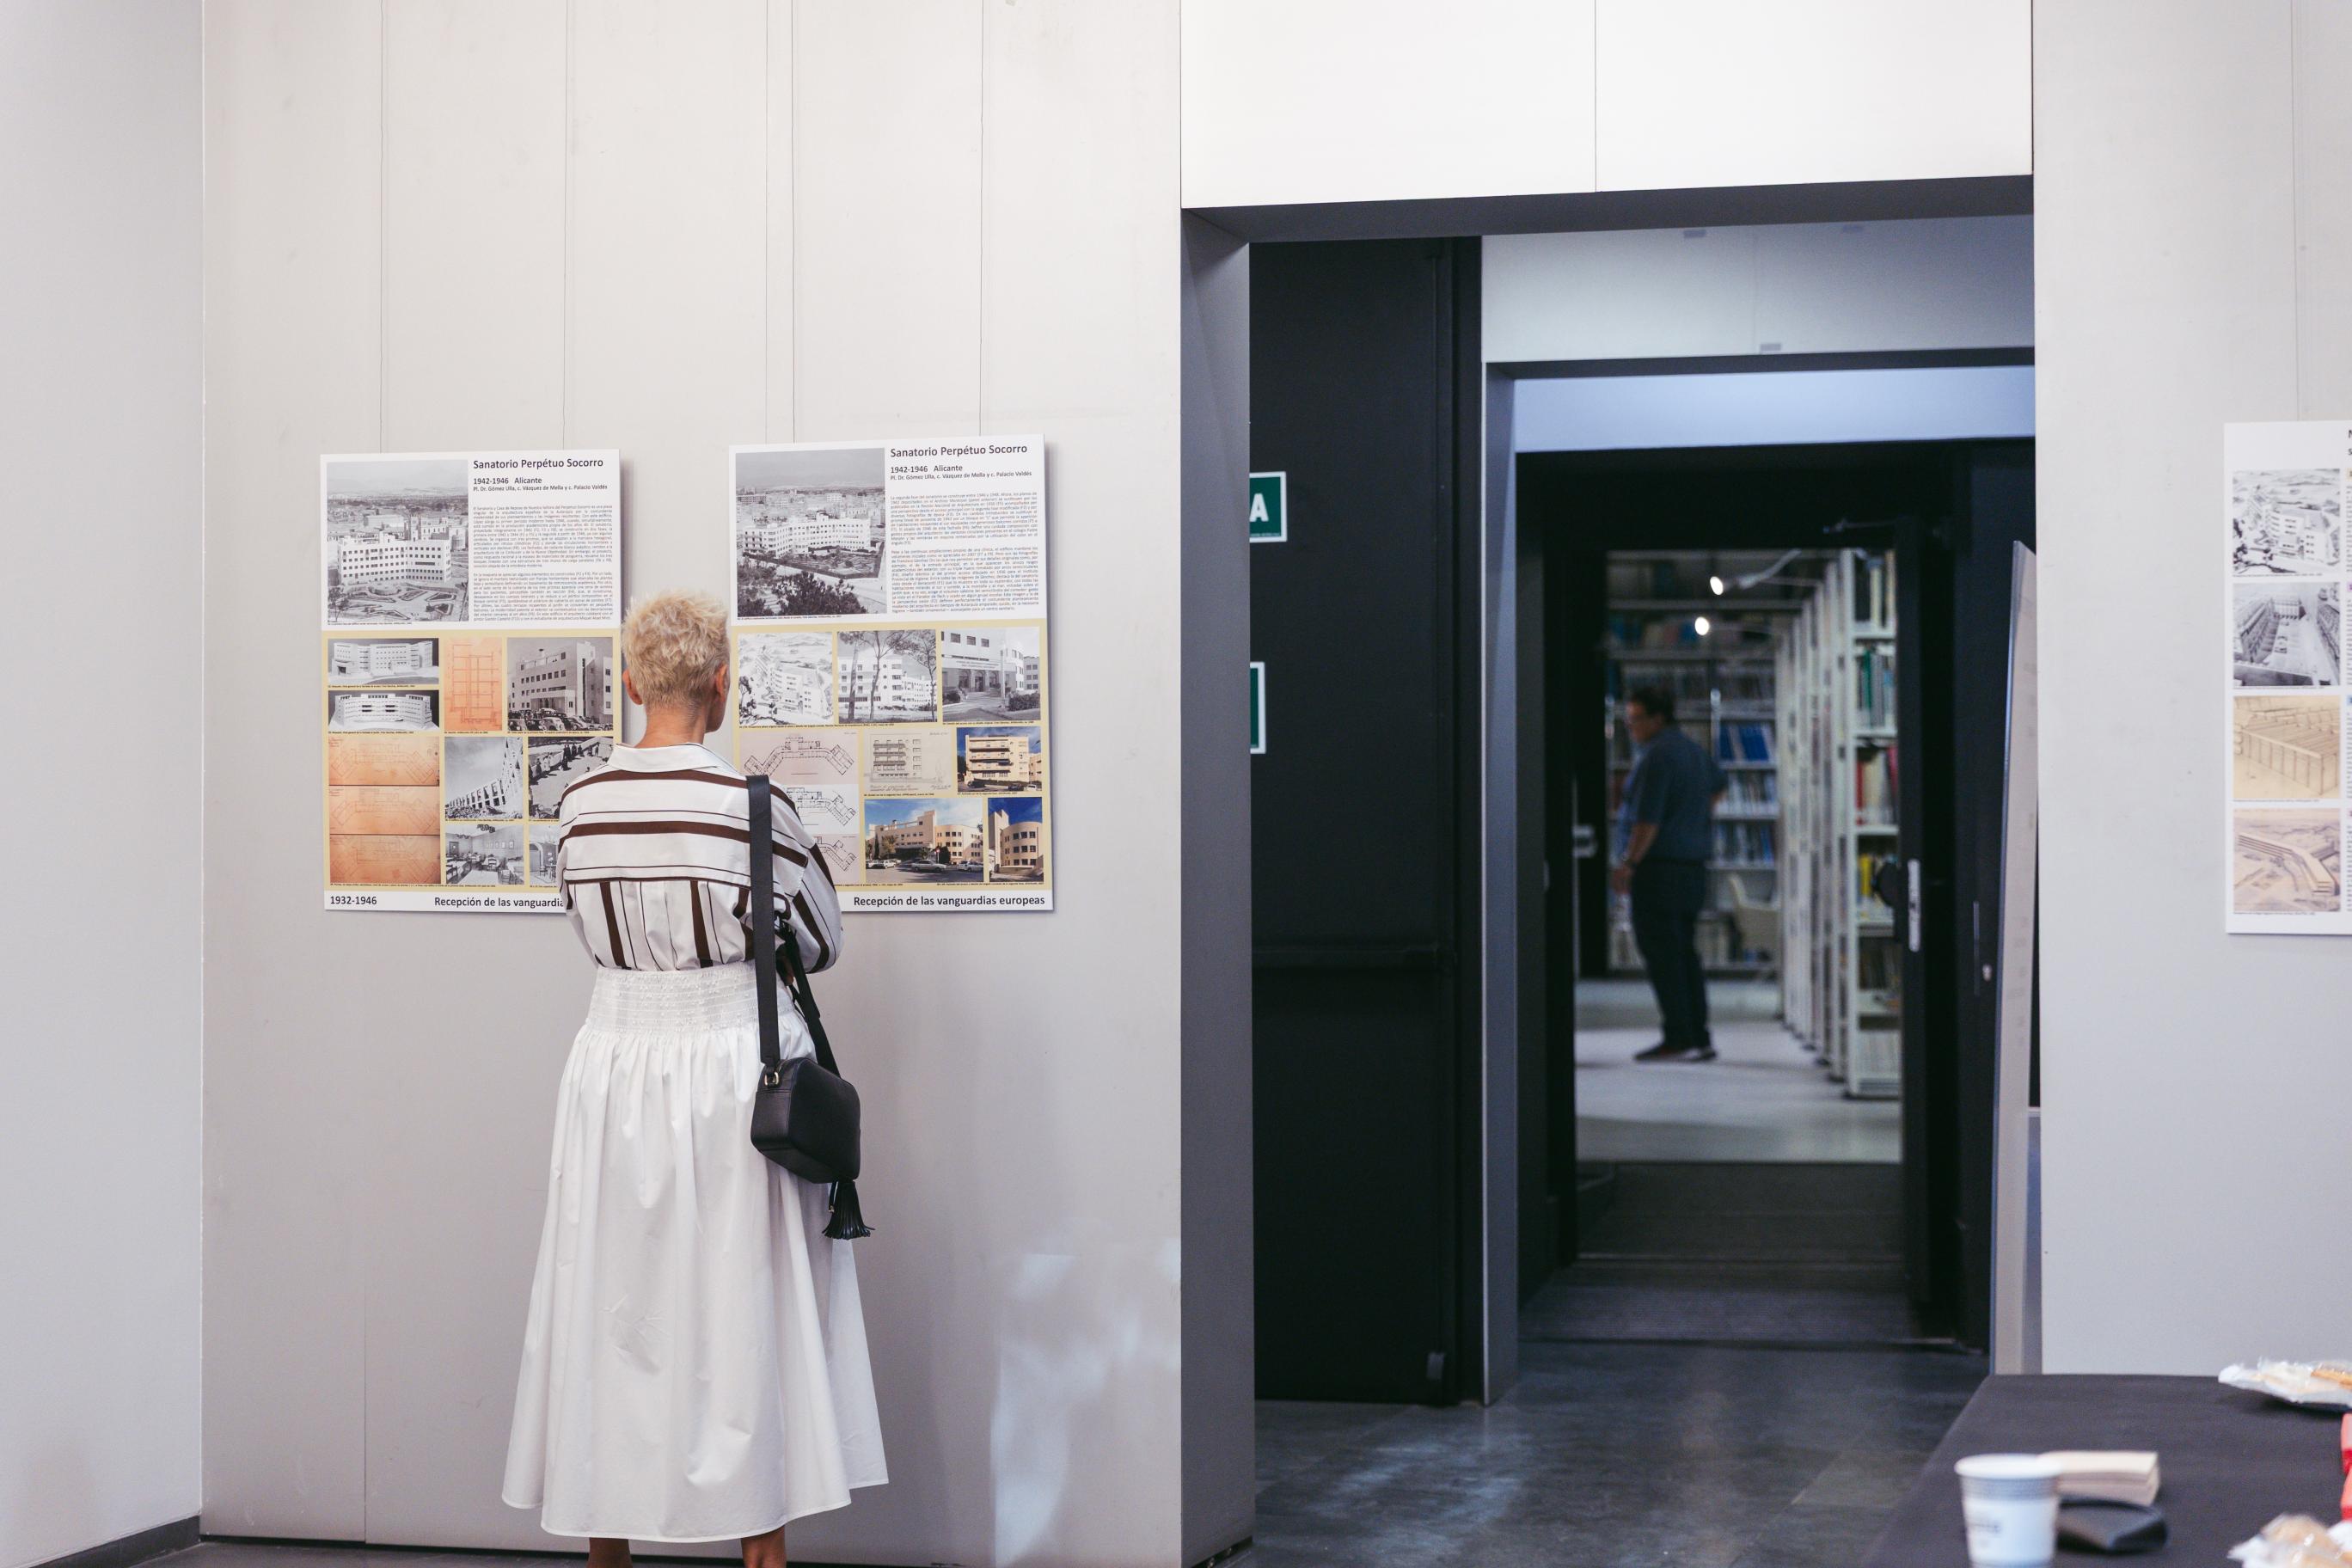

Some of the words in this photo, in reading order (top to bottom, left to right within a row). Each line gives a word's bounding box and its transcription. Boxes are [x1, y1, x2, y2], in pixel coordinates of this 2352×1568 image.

[890, 447, 938, 457] Sanatorio
[940, 445, 986, 457] Perpétuo
[989, 444, 1027, 455] Socorro
[473, 459, 518, 469] Sanatorio
[521, 458, 565, 470] Perpétuo
[567, 458, 603, 468] Socorro
[890, 465, 928, 474] 1942-1946
[1249, 493, 1269, 522] A
[330, 896, 377, 905] 1932-1946
[434, 897, 481, 908] Recepción
[484, 897, 496, 907] de
[498, 897, 511, 907] las
[854, 896, 903, 908] Recepción
[906, 896, 918, 906] de
[921, 896, 934, 906] las
[937, 896, 997, 907] vanguardias
[999, 897, 1045, 906] europeas
